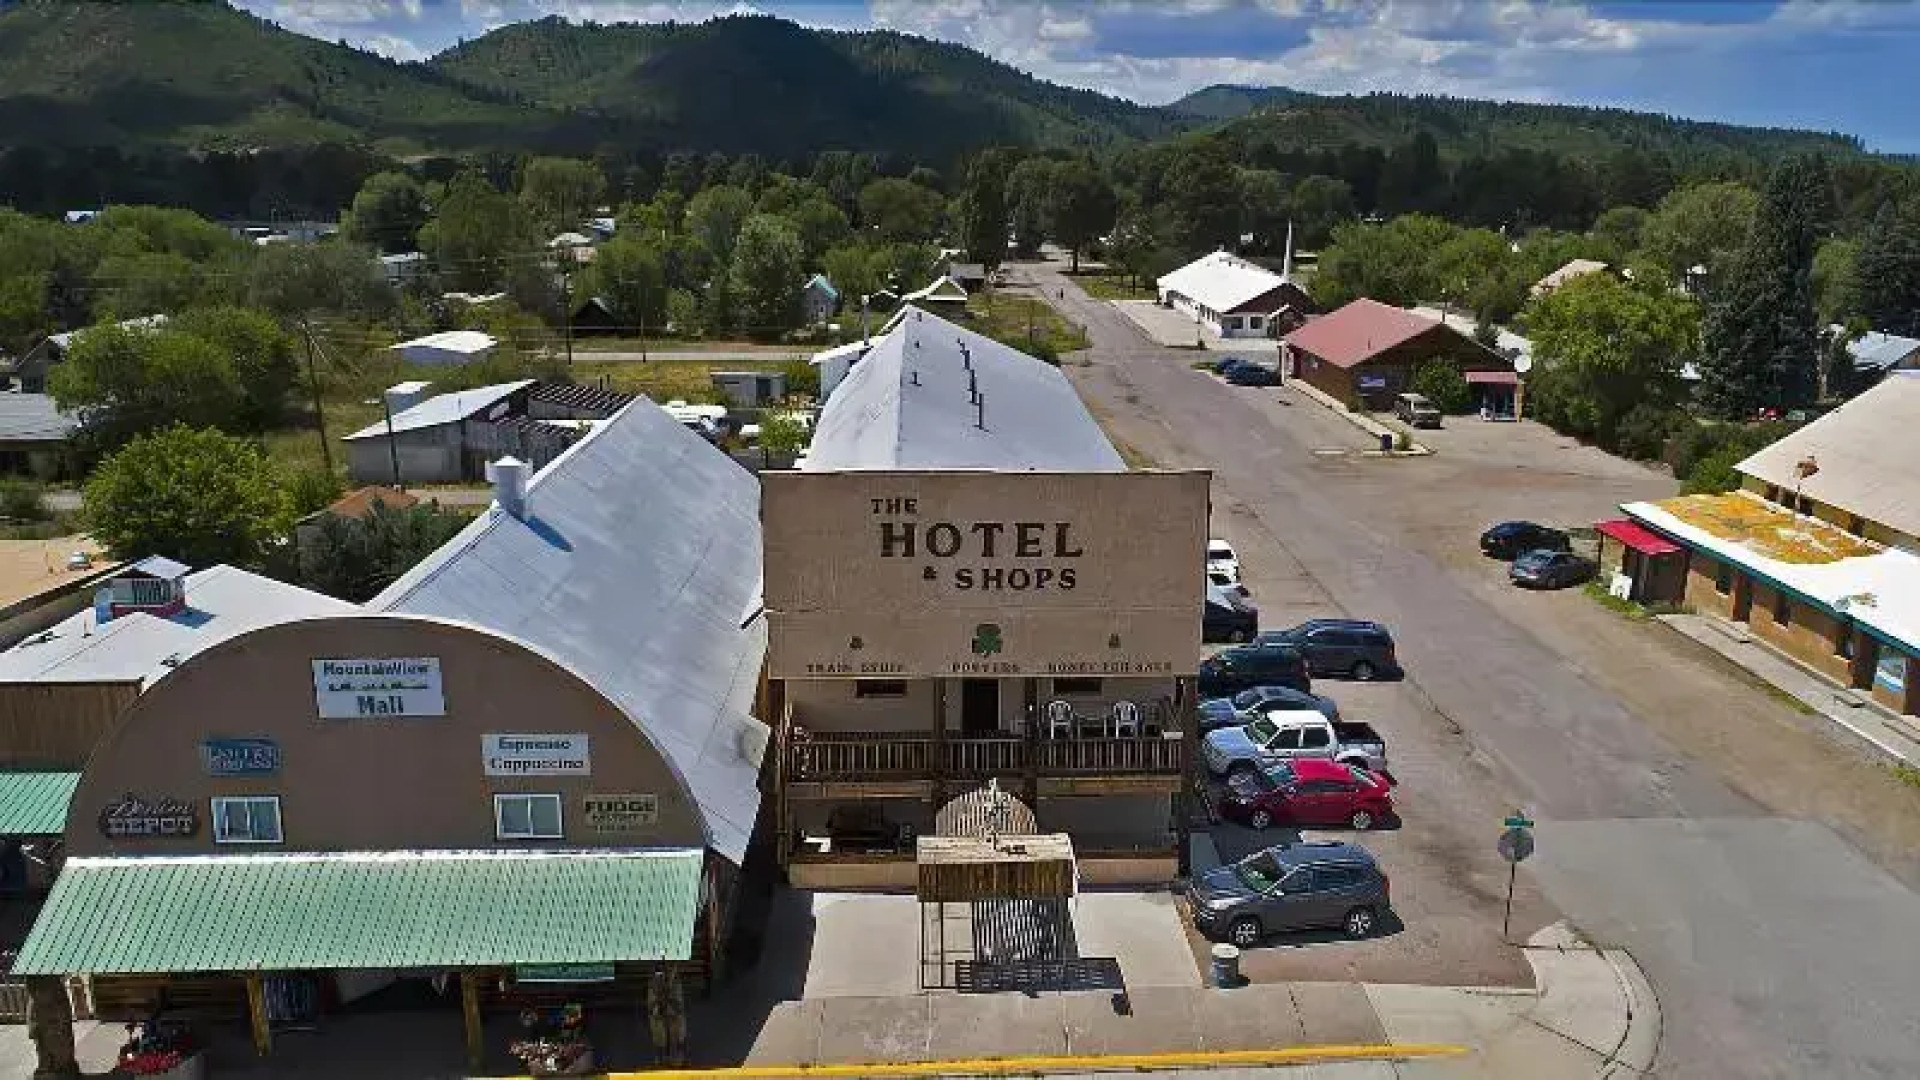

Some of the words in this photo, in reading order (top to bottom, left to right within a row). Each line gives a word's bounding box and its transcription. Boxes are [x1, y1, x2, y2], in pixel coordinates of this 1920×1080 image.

[871, 498, 918, 514] THE
[880, 522, 1083, 558] HOTEL
[922, 565, 937, 579] &
[955, 568, 1076, 589] SHOPS
[357, 695, 404, 714] Mall
[585, 801, 654, 813] FUDGE
[107, 817, 193, 834] DEPOT
